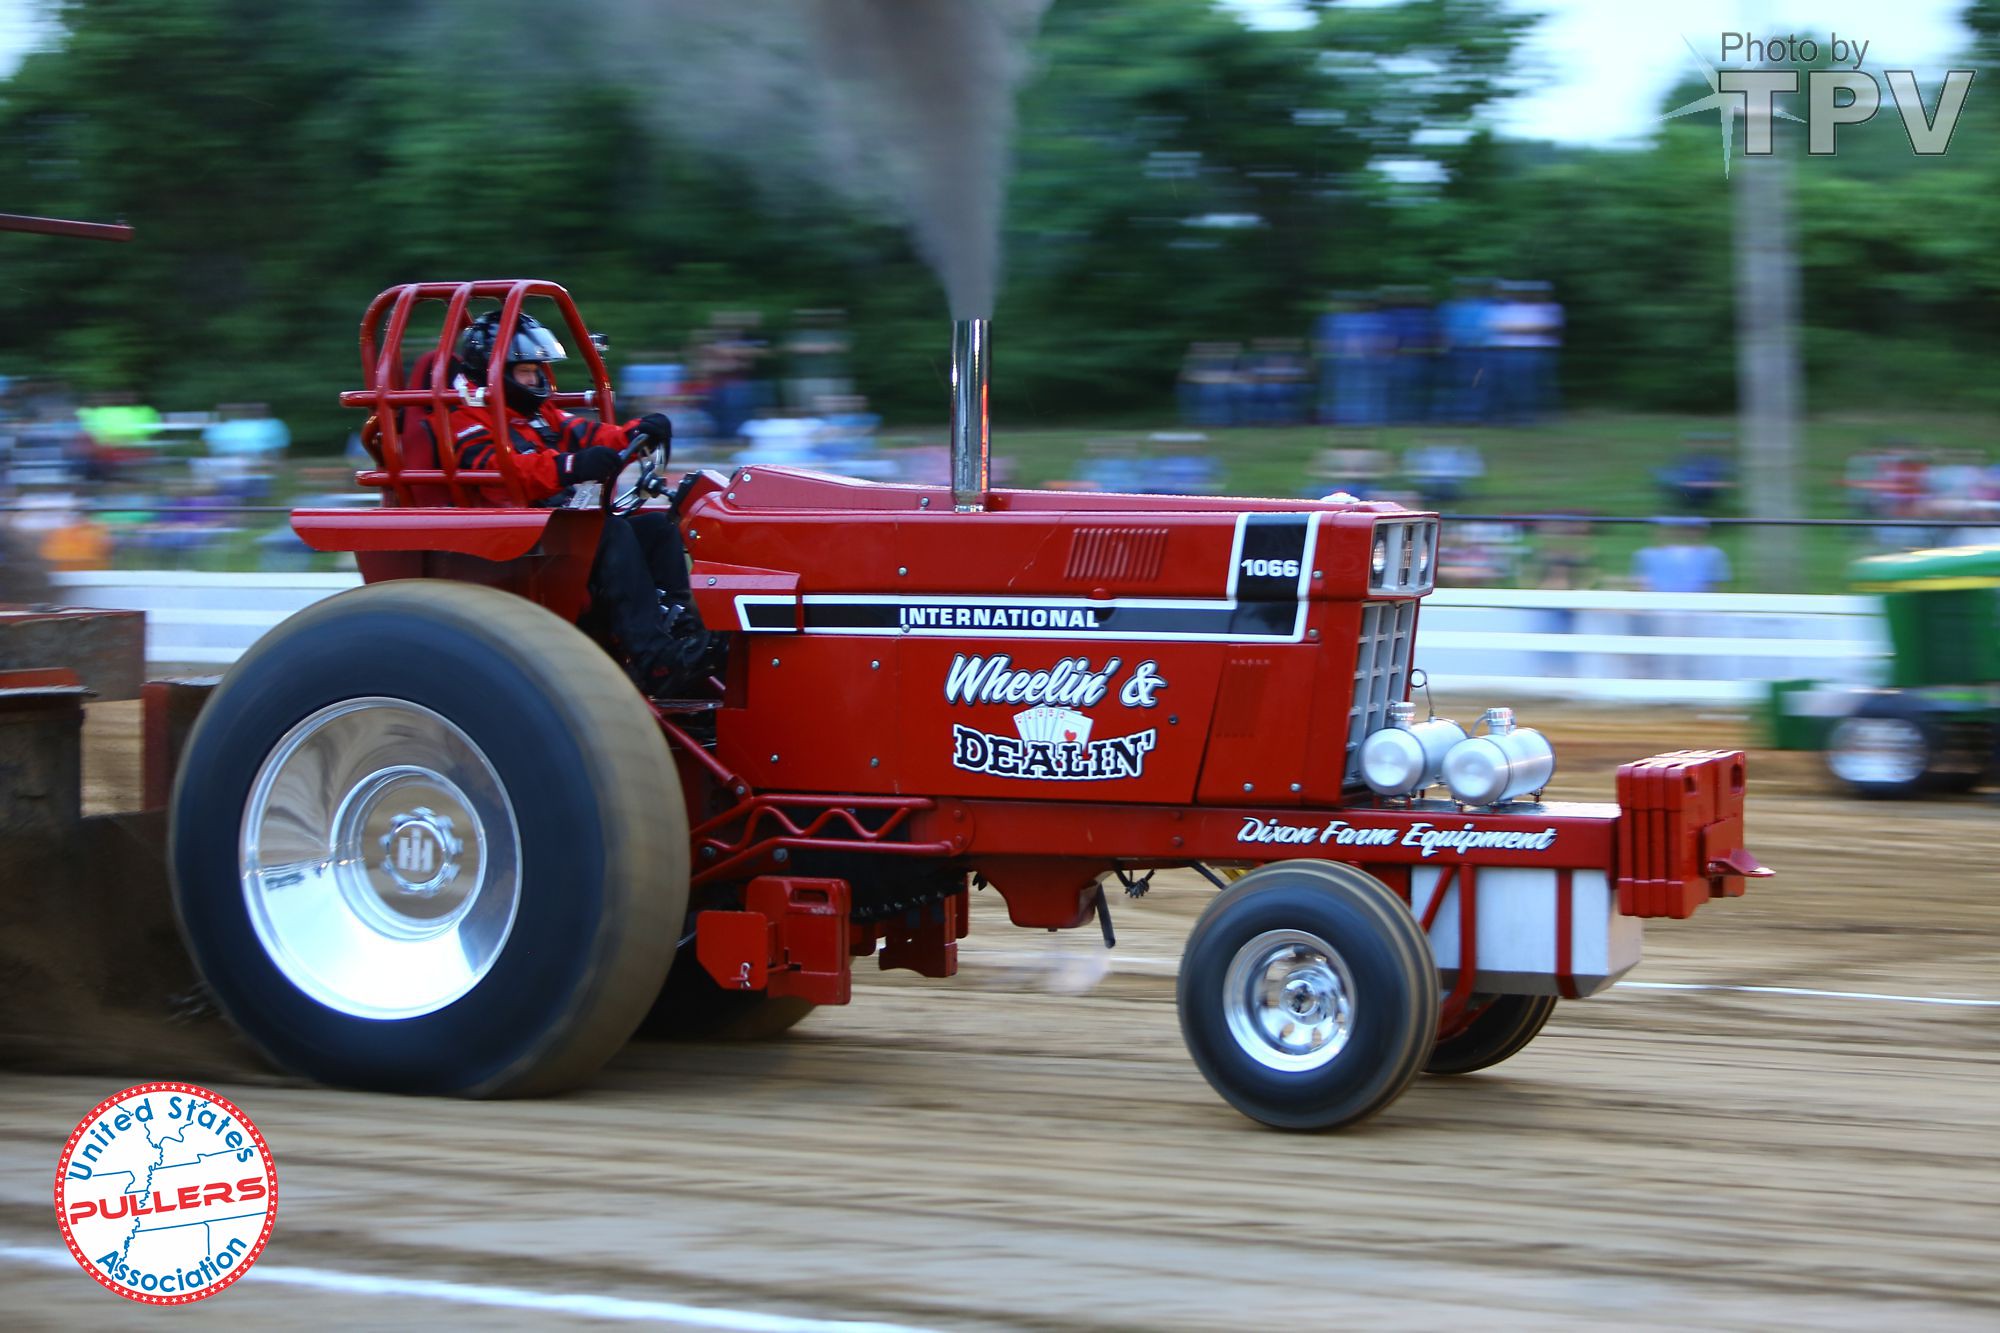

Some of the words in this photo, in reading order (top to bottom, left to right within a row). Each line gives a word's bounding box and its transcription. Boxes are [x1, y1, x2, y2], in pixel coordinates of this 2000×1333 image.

[1241, 559, 1299, 577] 1066
[900, 607, 1100, 628] INTERNATIONAL
[944, 652, 1121, 707] Wheelin'
[1120, 659, 1168, 707] &
[952, 723, 1157, 780] DEALIN'
[1237, 817, 1319, 844] Dixon
[1319, 820, 1399, 845] Farm
[1400, 822, 1557, 857] Equipment
